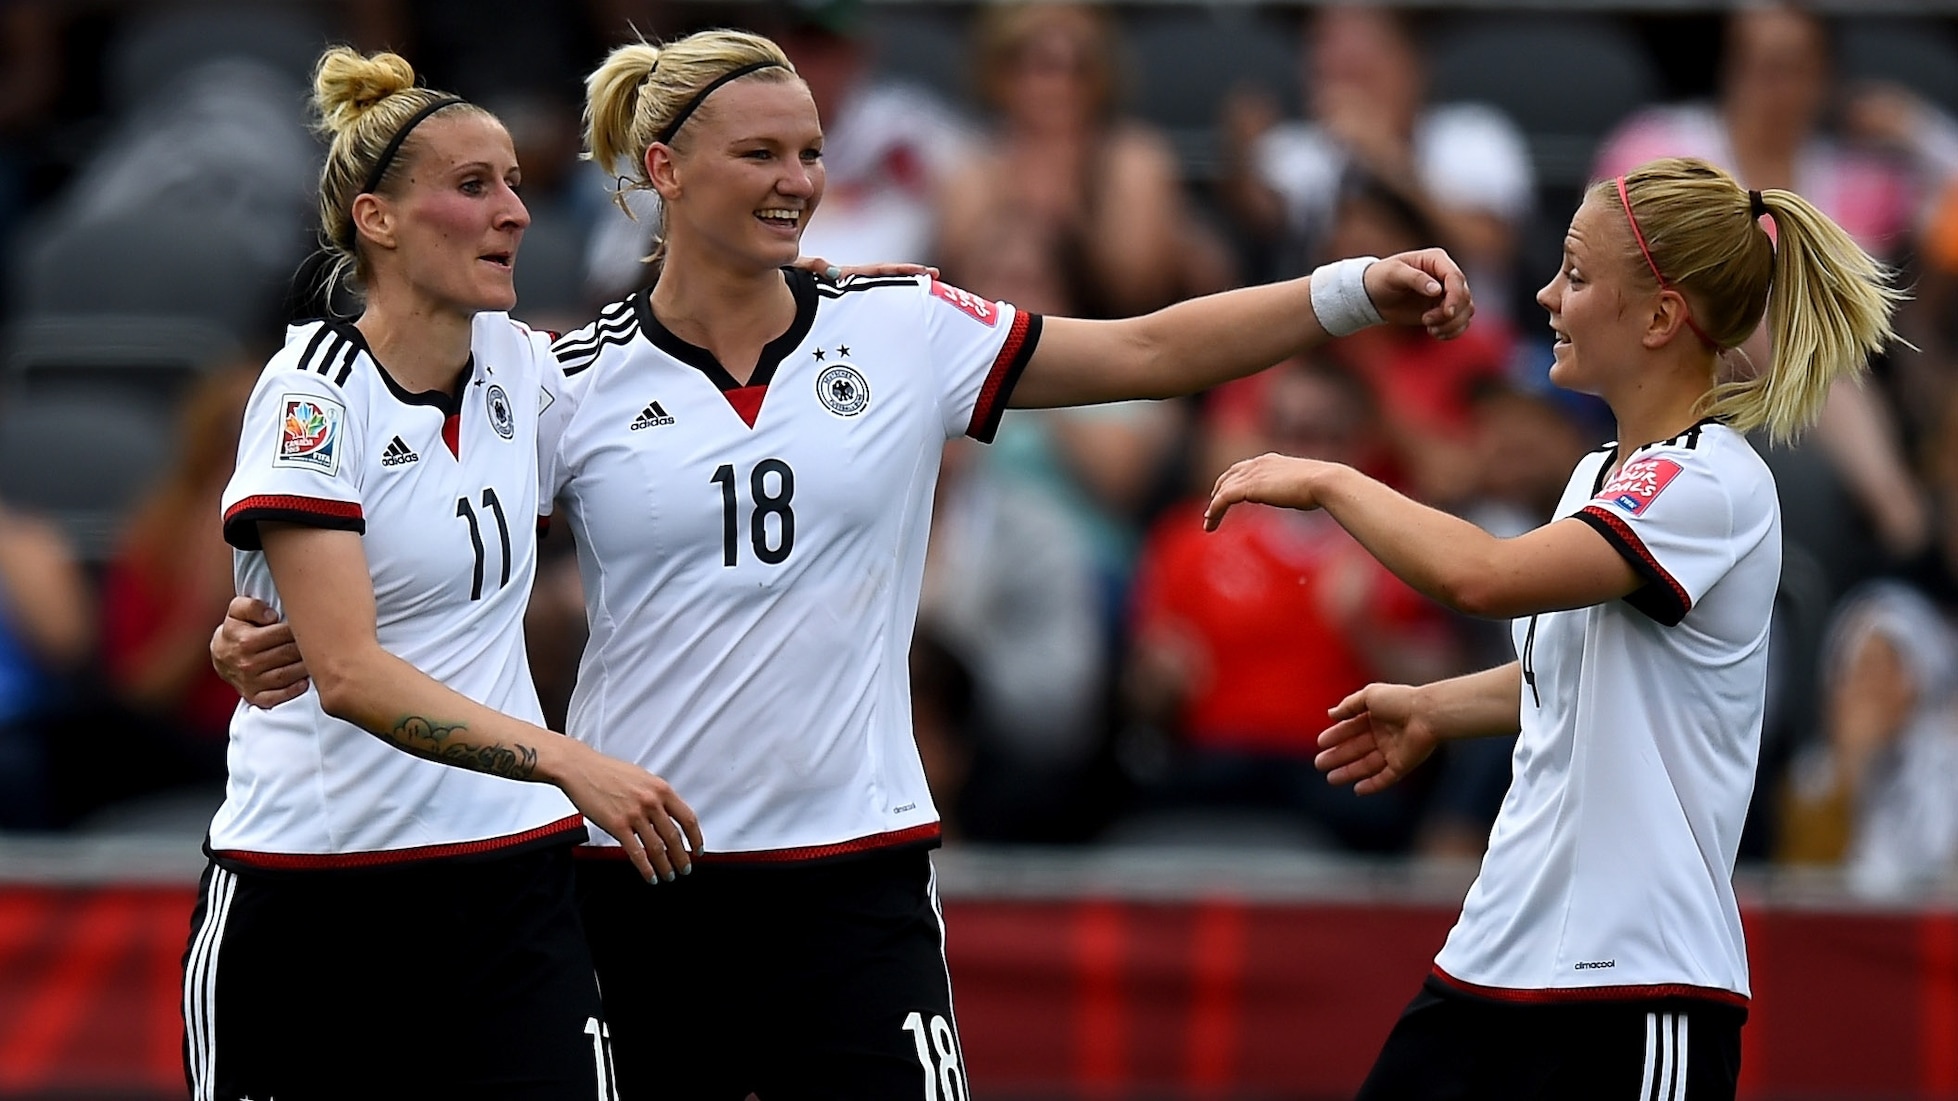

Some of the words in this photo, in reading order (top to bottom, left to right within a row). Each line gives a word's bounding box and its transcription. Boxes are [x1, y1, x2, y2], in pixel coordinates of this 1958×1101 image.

[382, 453, 419, 467] adidas
[630, 416, 675, 430] adidas
[456, 487, 511, 601] 11
[709, 458, 794, 567] 18
[1522, 614, 1540, 708] 4
[1574, 959, 1615, 970] climacool
[902, 1011, 967, 1101] 18
